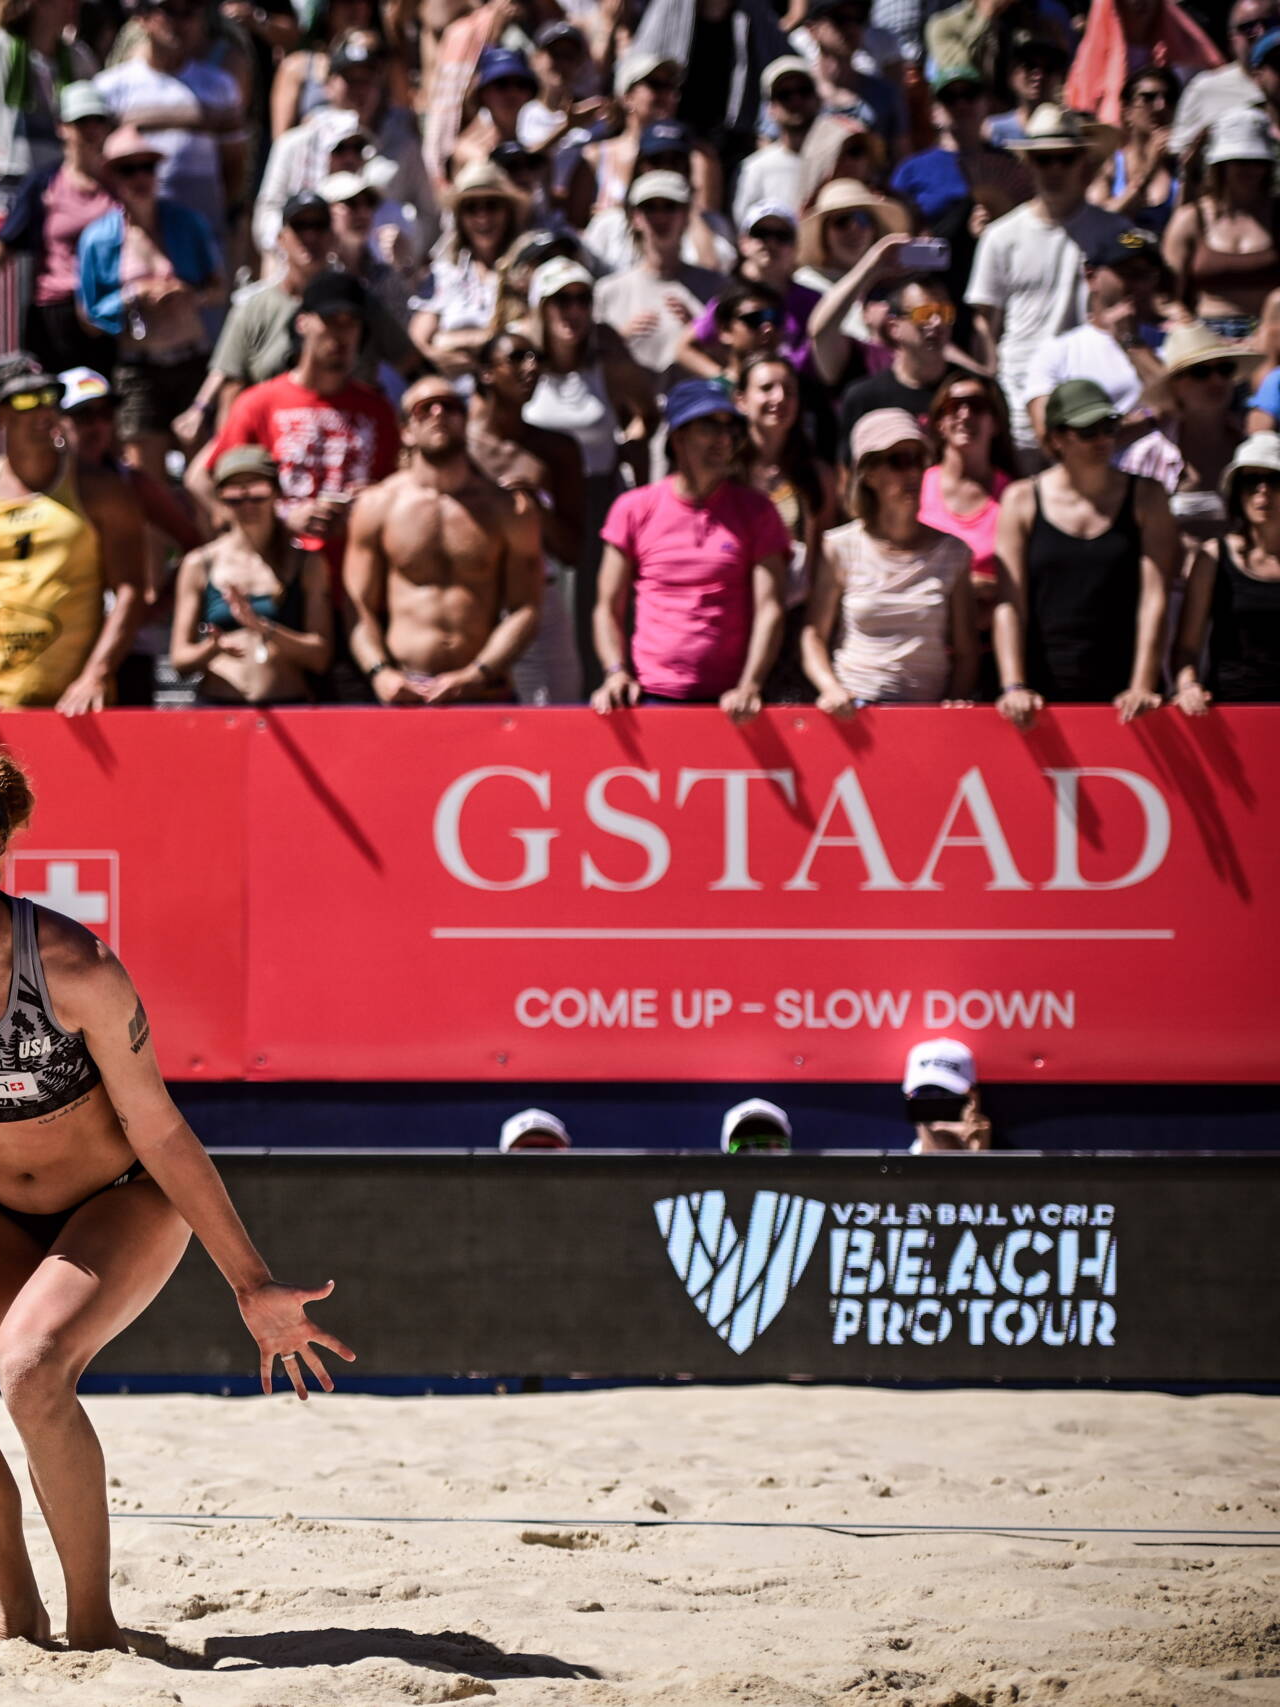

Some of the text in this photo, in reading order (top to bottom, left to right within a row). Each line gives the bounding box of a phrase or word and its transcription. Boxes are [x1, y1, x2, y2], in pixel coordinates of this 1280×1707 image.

[433, 766, 1172, 891] GSTAAD
[516, 987, 659, 1030] COME
[672, 989, 732, 1029] UP
[775, 987, 912, 1030] SLOW
[923, 989, 1076, 1030] DOWN
[19, 1035, 52, 1059] USA
[829, 1228, 1118, 1297] BEACH
[829, 1299, 1118, 1347] PRO TOUR
